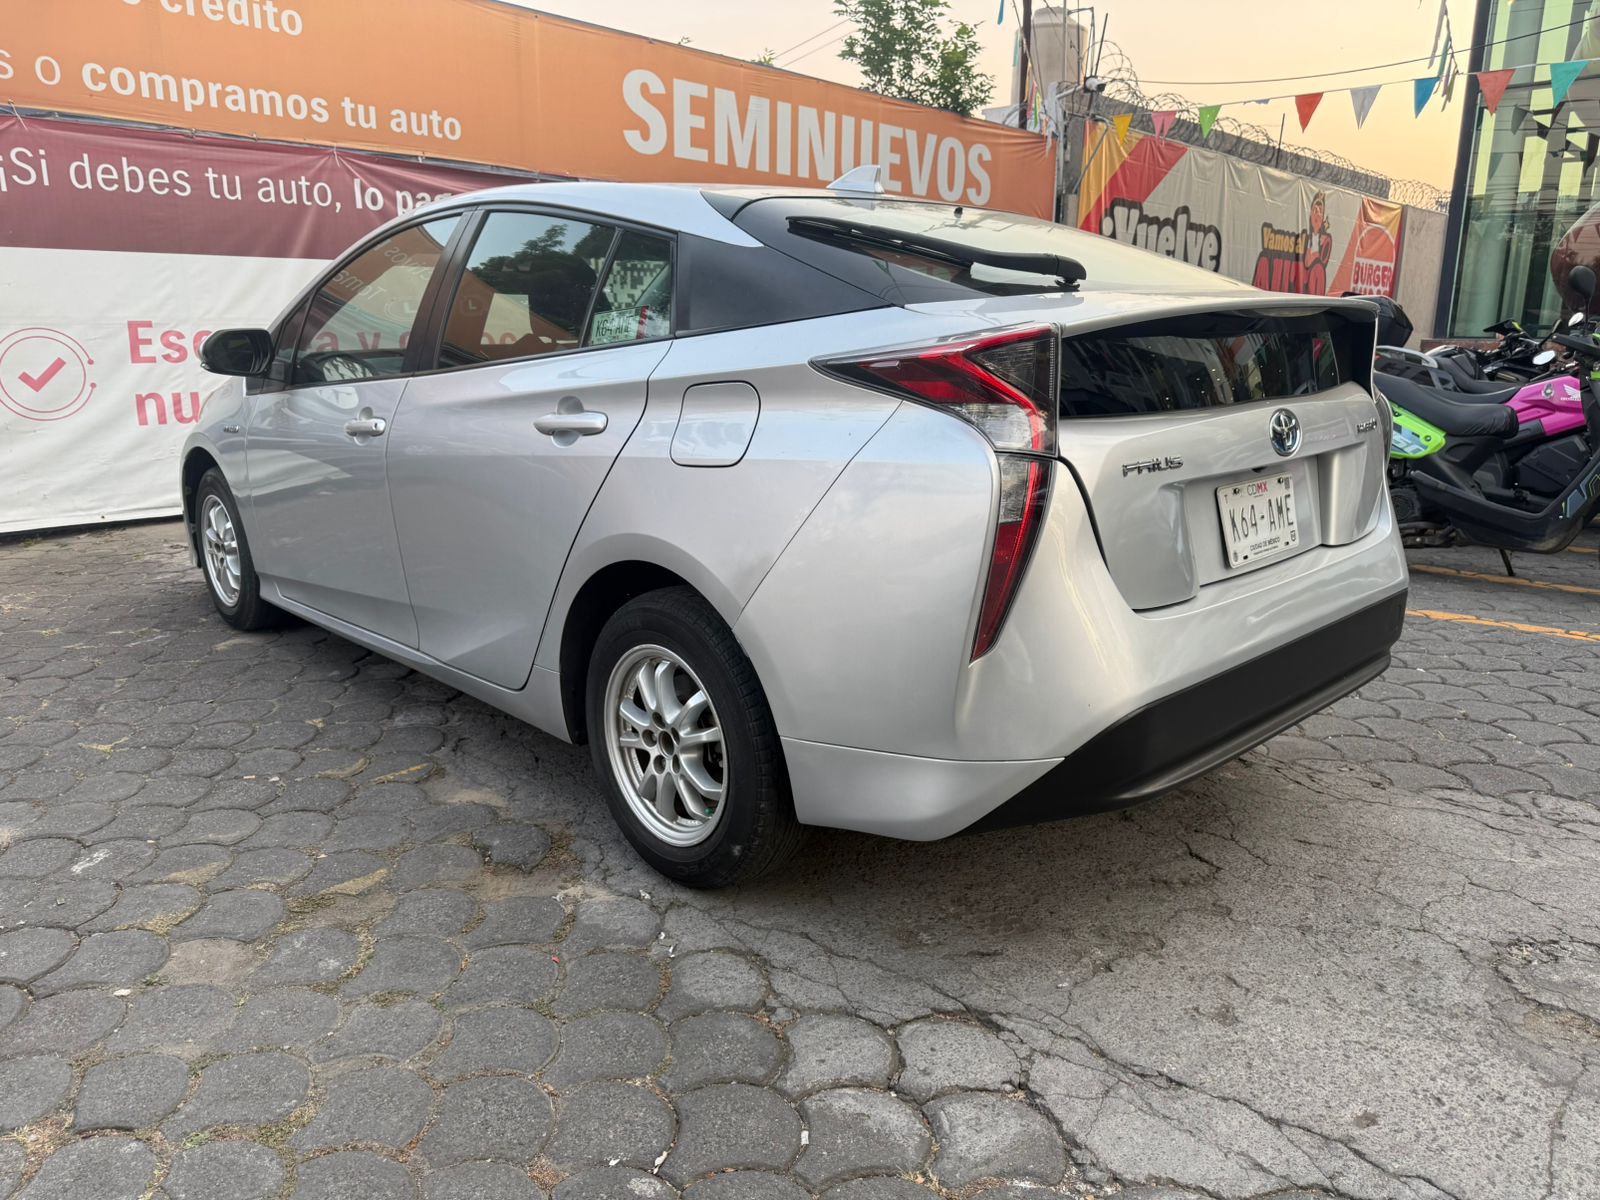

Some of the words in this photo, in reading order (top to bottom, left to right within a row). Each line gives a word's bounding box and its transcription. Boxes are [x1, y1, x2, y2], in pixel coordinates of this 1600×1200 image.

[35, 55, 61, 86] o
[82, 61, 329, 124] compramos
[341, 96, 377, 130] tu
[390, 108, 462, 142] auto
[622, 69, 992, 206] SEMINUEVOS
[69, 153, 192, 197] debes
[204, 167, 242, 200] tu
[257, 175, 342, 213] auto,
[353, 178, 384, 211] lo
[1263, 226, 1295, 252] Vamos
[1353, 262, 1393, 289] BURGER
[1122, 455, 1184, 477] PRIUS
[1247, 482, 1268, 495] CDMX
[1229, 494, 1294, 543] K64-AME
